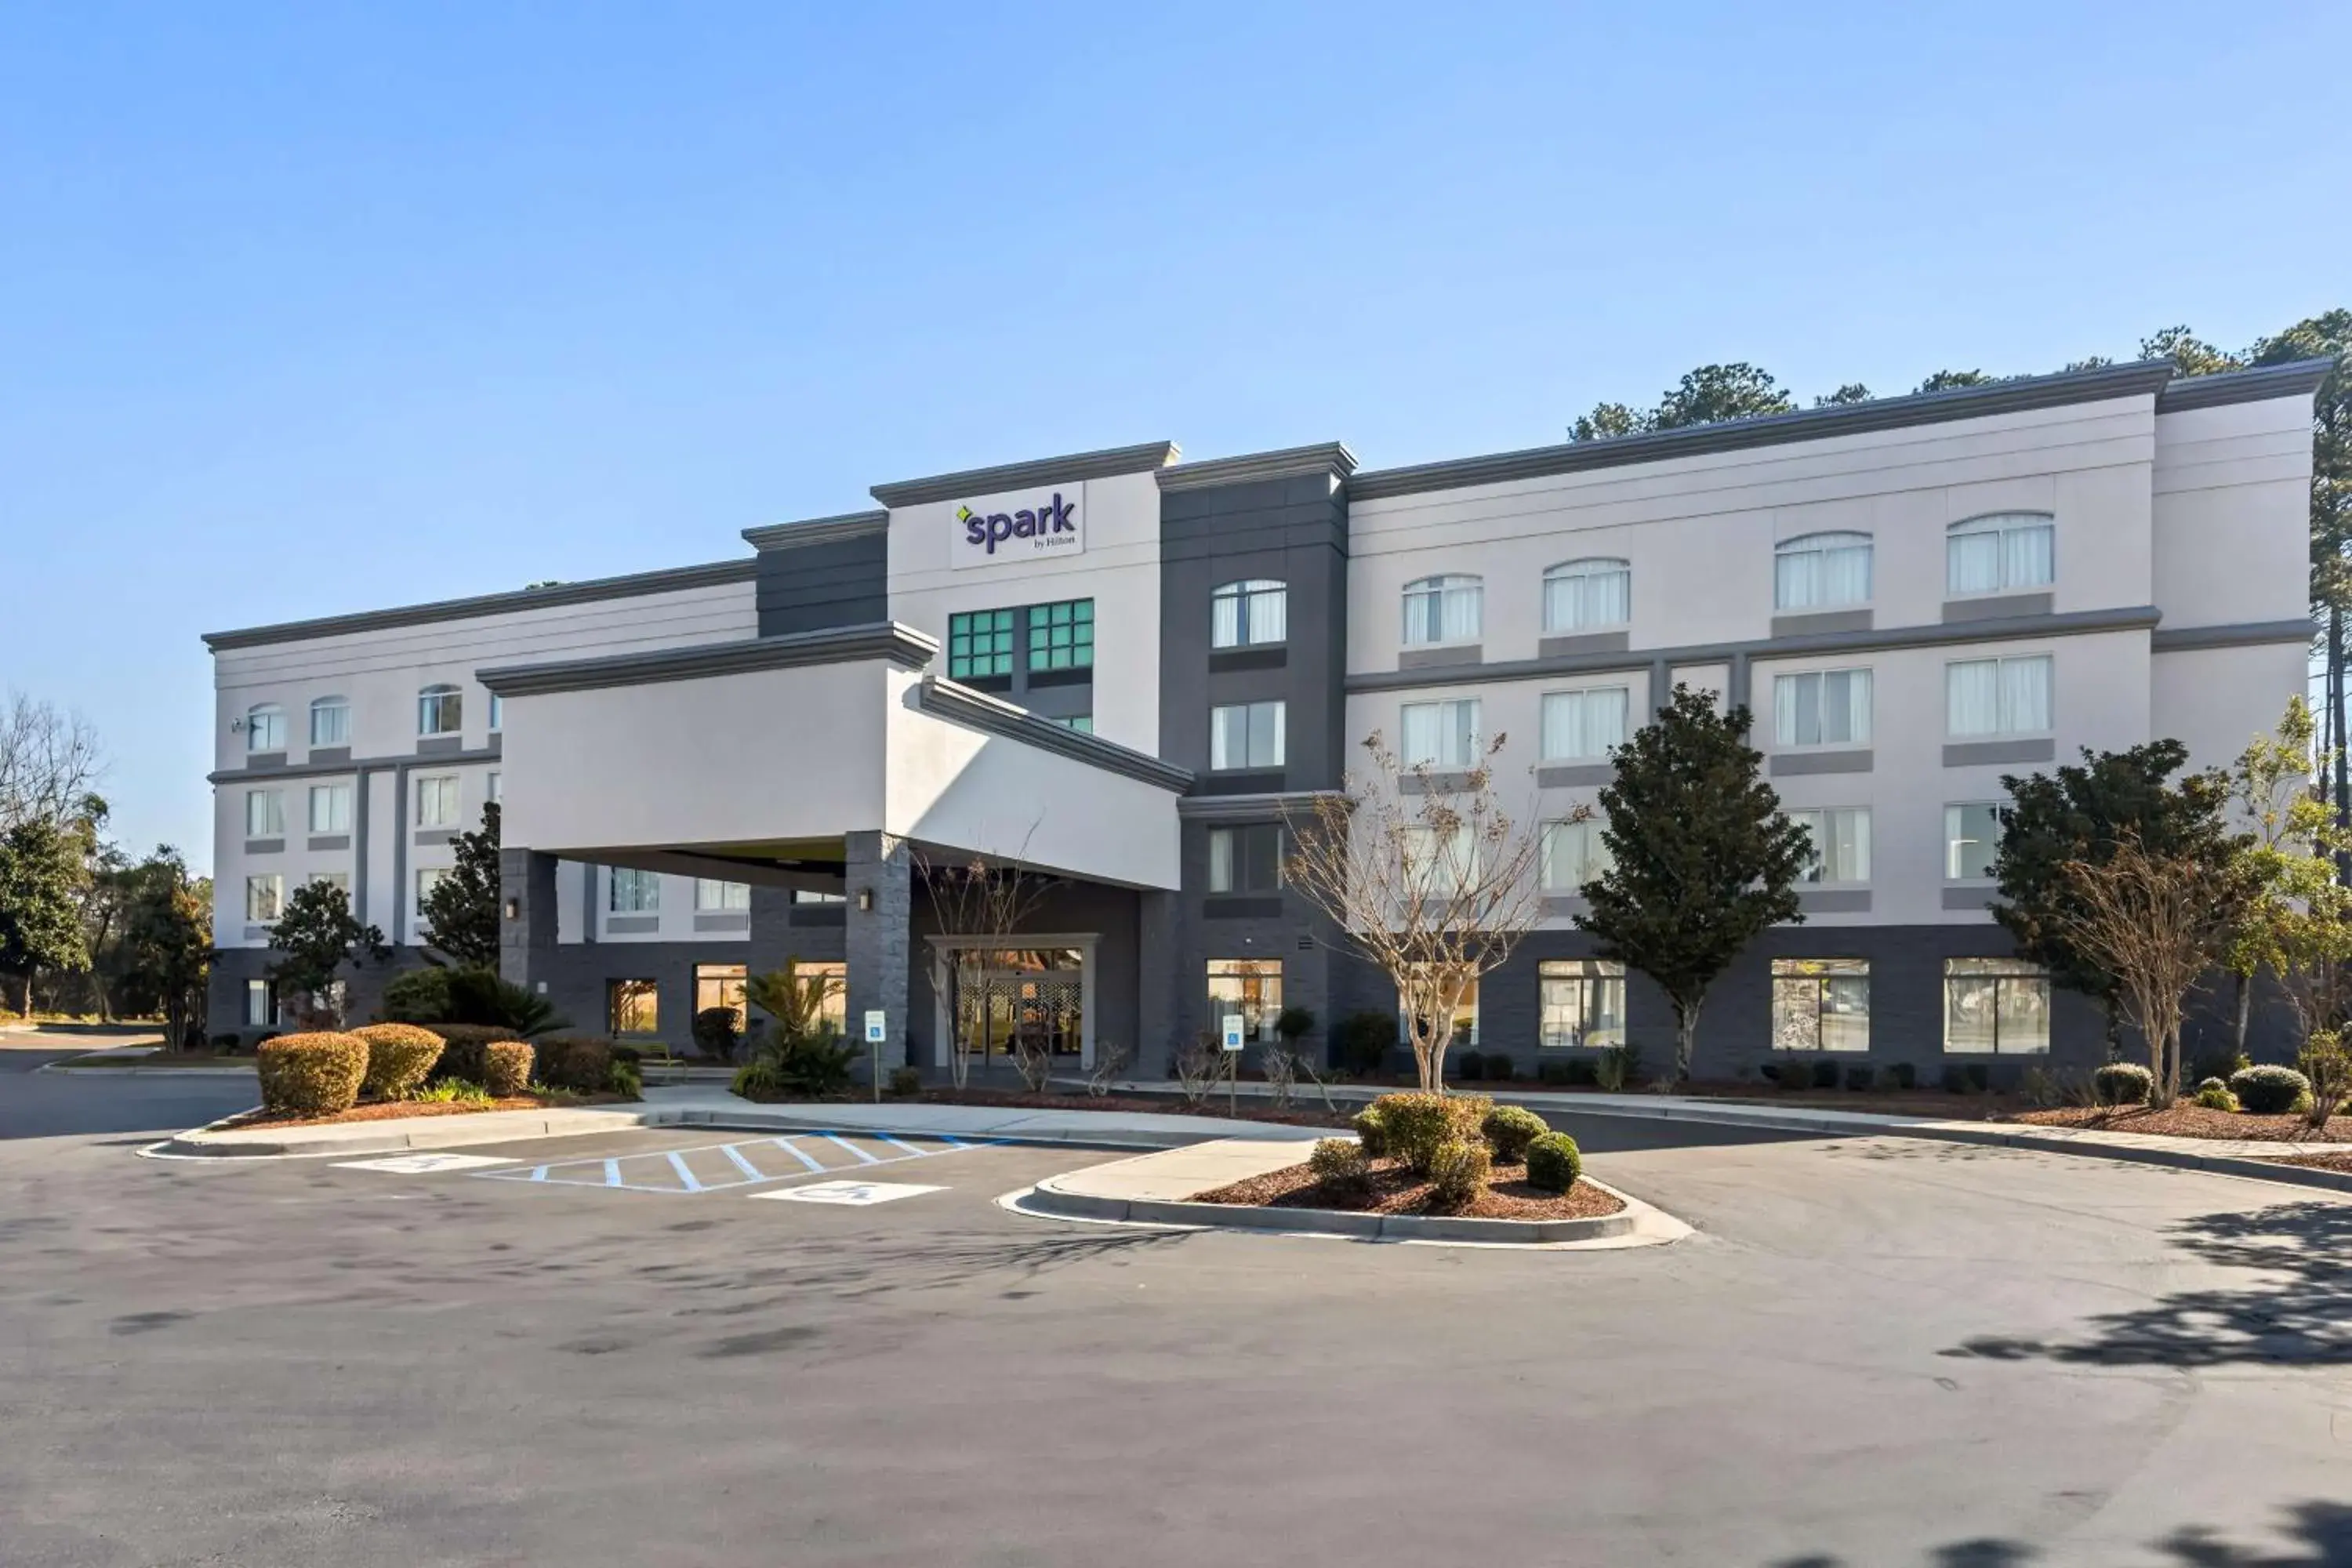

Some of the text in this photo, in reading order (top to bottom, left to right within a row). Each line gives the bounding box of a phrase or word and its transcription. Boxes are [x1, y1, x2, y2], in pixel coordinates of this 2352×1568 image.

[966, 492, 1076, 554] spark
[1034, 536, 1076, 550] by Hilton
